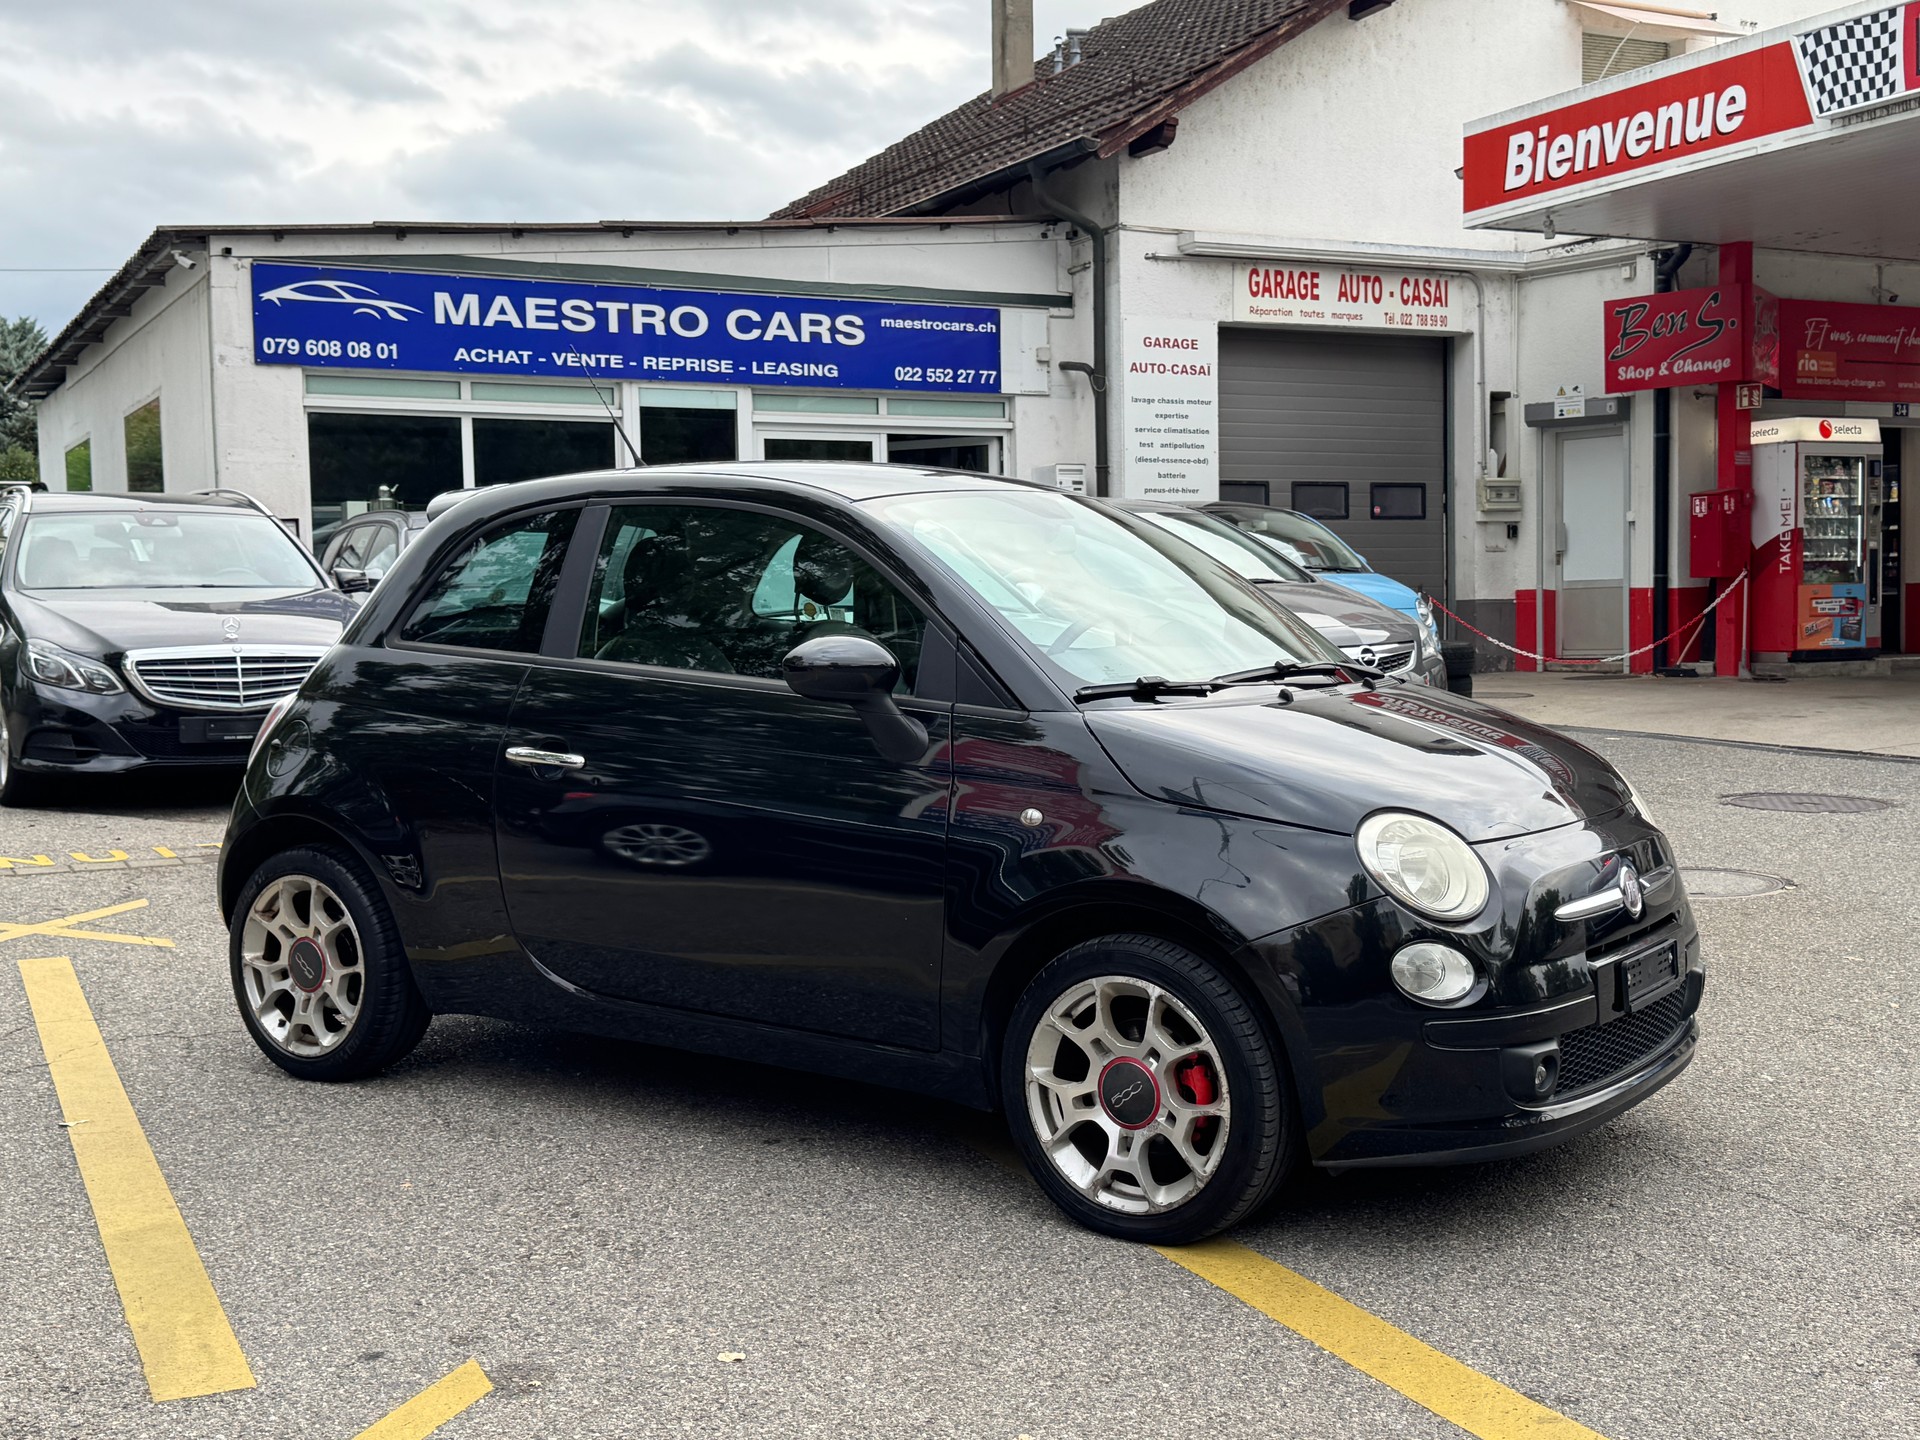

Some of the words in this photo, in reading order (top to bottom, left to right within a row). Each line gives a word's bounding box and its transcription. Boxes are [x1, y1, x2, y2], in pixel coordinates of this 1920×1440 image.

[1504, 84, 1747, 192] Bienvenue
[1248, 267, 1320, 301] GARAGE
[1337, 273, 1383, 304] AUTO
[1400, 276, 1449, 308] CASAI
[433, 290, 709, 338] MAESTRO
[725, 308, 866, 346] CARS
[1249, 305, 1293, 318] Réparation
[1299, 308, 1325, 319] toutes
[1331, 311, 1364, 323] marques
[1400, 312, 1413, 326] 022
[880, 316, 997, 334] maestrocars.ch
[1609, 301, 1689, 362] Ben
[262, 336, 300, 356] 079
[304, 338, 342, 358] 608
[346, 339, 372, 359] 08
[376, 342, 398, 360] 01
[1142, 336, 1199, 350] GARAGE
[454, 347, 533, 365] ACHAT
[551, 352, 624, 369] VENTE
[642, 356, 734, 373] REPRISE
[752, 361, 839, 378] LEASING
[1617, 365, 1655, 381] Shop
[1658, 361, 1670, 376] &
[1672, 356, 1732, 375] Change
[1797, 353, 1819, 371] ria
[894, 366, 922, 382] 022
[926, 367, 954, 383] 552
[957, 369, 976, 384] 27
[978, 370, 997, 385] 77
[1131, 396, 1156, 405] lavage
[1157, 397, 1185, 405] chassis
[1186, 398, 1212, 406] moteur
[1896, 404, 1907, 416] 34
[1154, 412, 1190, 421] expertise
[1134, 426, 1162, 434] service
[1163, 427, 1210, 435] climatisation
[1751, 426, 1779, 438] selecta
[1833, 424, 1862, 435] selecta
[1139, 441, 1154, 449] test
[1160, 441, 1205, 451] antipollution
[1157, 471, 1186, 479] batterie
[1780, 497, 1792, 527] ME!
[1779, 531, 1792, 574] TAKE
[1110, 1080, 1144, 1109] 500
